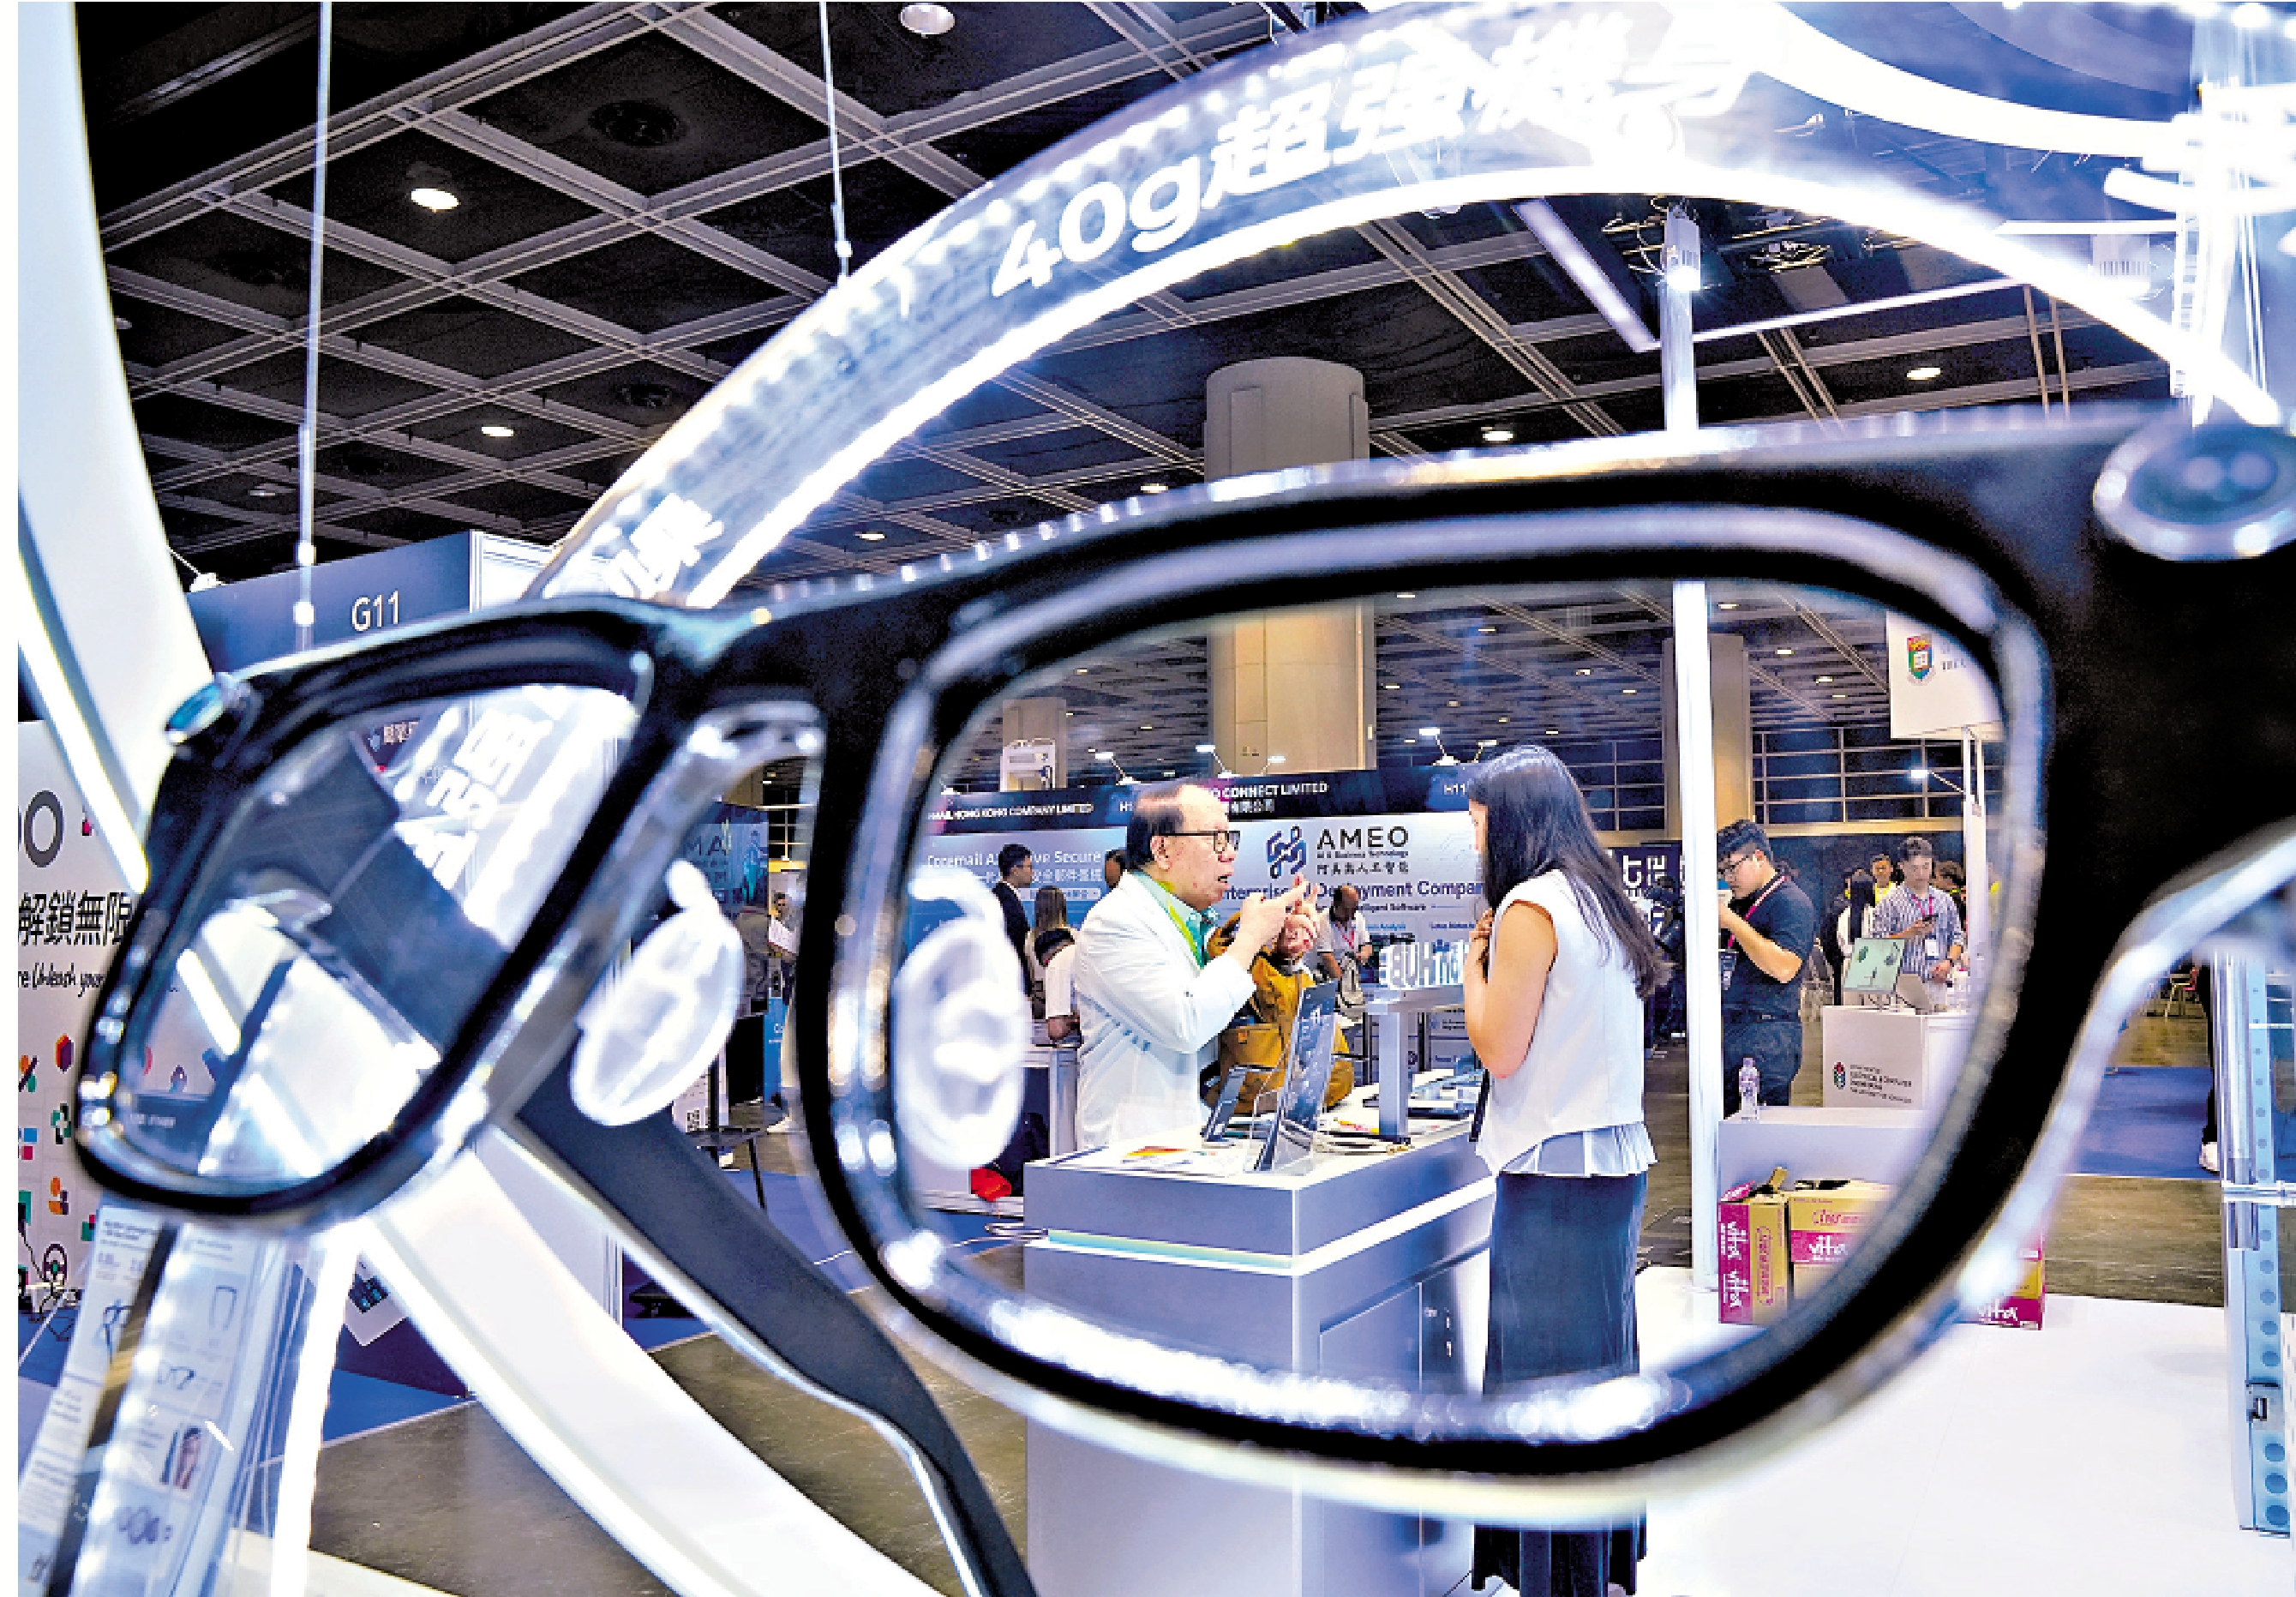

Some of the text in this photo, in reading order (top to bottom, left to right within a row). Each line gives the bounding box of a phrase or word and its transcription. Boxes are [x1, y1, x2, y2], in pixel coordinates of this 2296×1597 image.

[351, 590, 400, 633] G11
[1316, 826, 1409, 850] AMEO
[1054, 850, 1102, 863] Secure
[1808, 1234, 1849, 1257] vita
